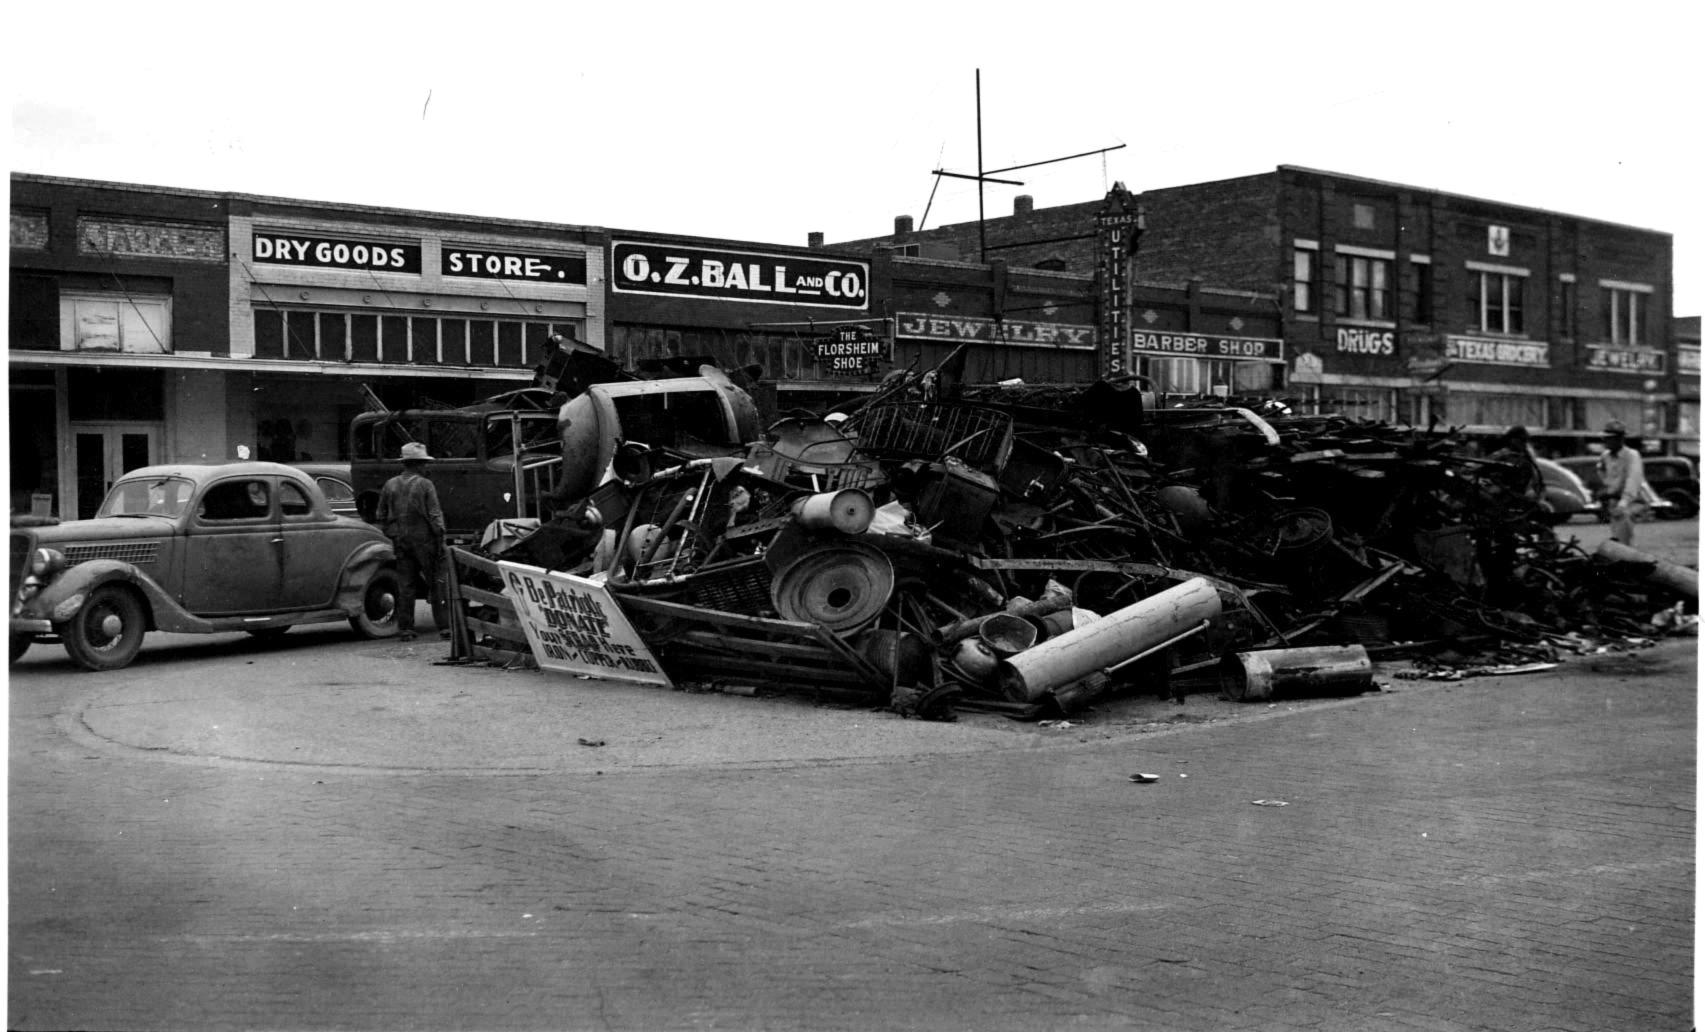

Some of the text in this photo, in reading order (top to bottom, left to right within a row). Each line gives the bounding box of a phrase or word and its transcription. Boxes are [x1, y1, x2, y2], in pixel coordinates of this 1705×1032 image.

[255, 236, 311, 261] DRY
[315, 242, 405, 268] GOODS
[796, 275, 823, 290] AND
[824, 270, 865, 298] CO.
[1111, 229, 1121, 372] UTILITIES
[818, 342, 879, 356] FLORSHEIM
[840, 331, 857, 341] THE
[1134, 333, 1265, 356] BARBER SHOP
[1337, 328, 1395, 355] DRUGS
[833, 357, 863, 369] SHOE
[522, 575, 548, 605] Be
[529, 621, 562, 644] Your
[543, 607, 611, 638] DONATE
